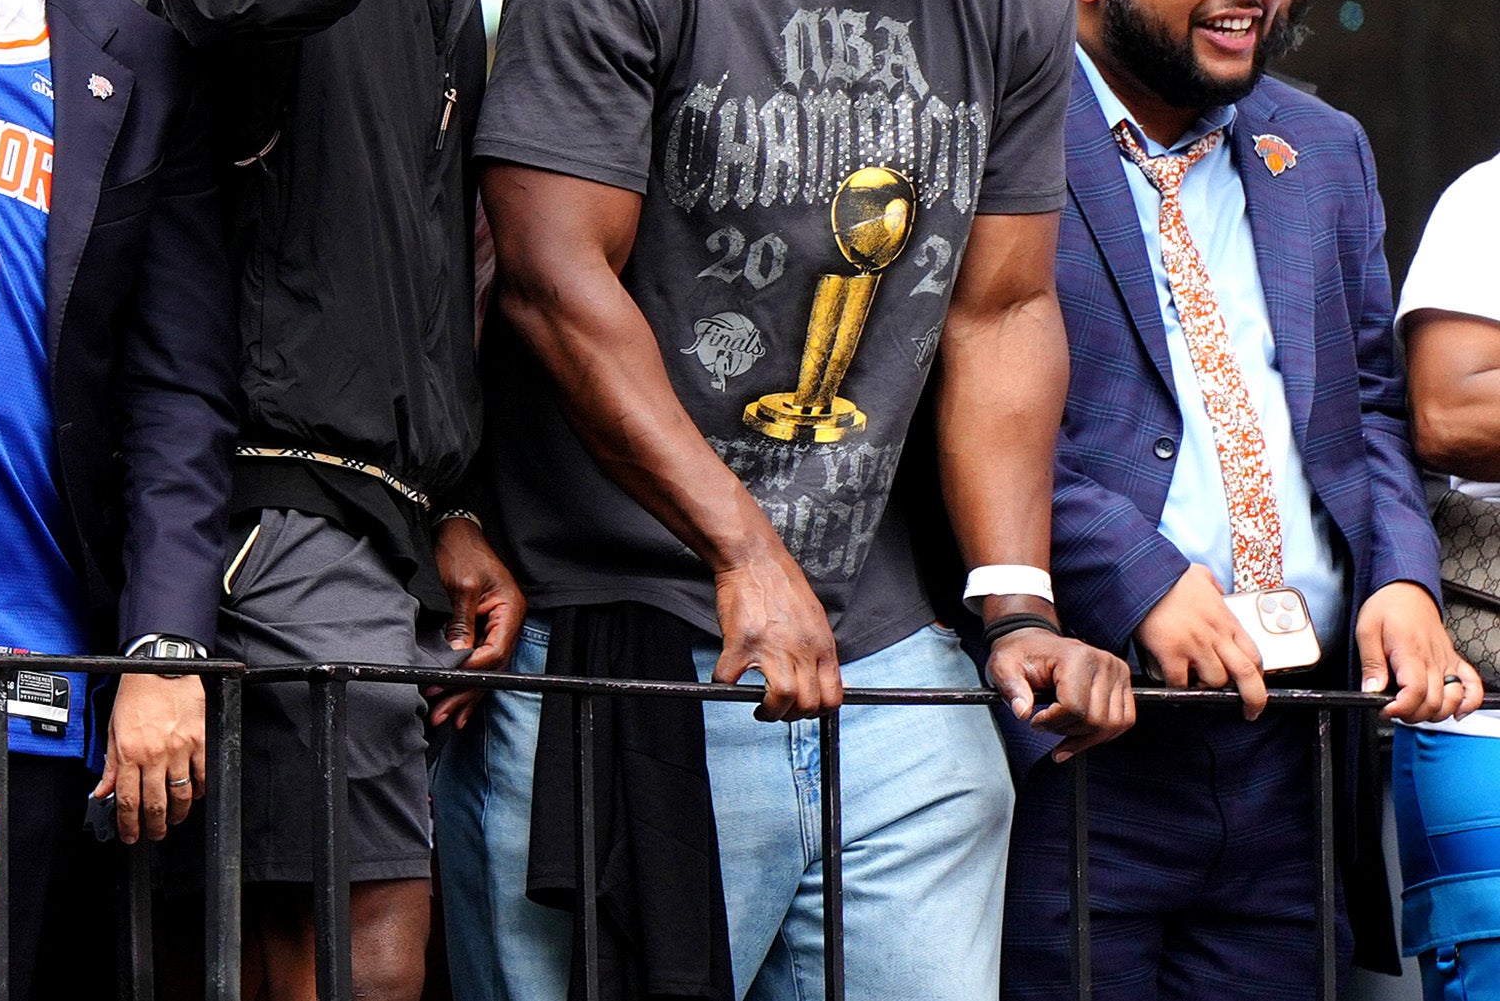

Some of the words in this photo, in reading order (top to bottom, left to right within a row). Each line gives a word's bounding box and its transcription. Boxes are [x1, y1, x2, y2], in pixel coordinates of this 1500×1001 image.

[780, 6, 930, 100] NBA
[696, 224, 788, 291] 20
[910, 234, 956, 297] 2
[680, 317, 766, 359] Finals
